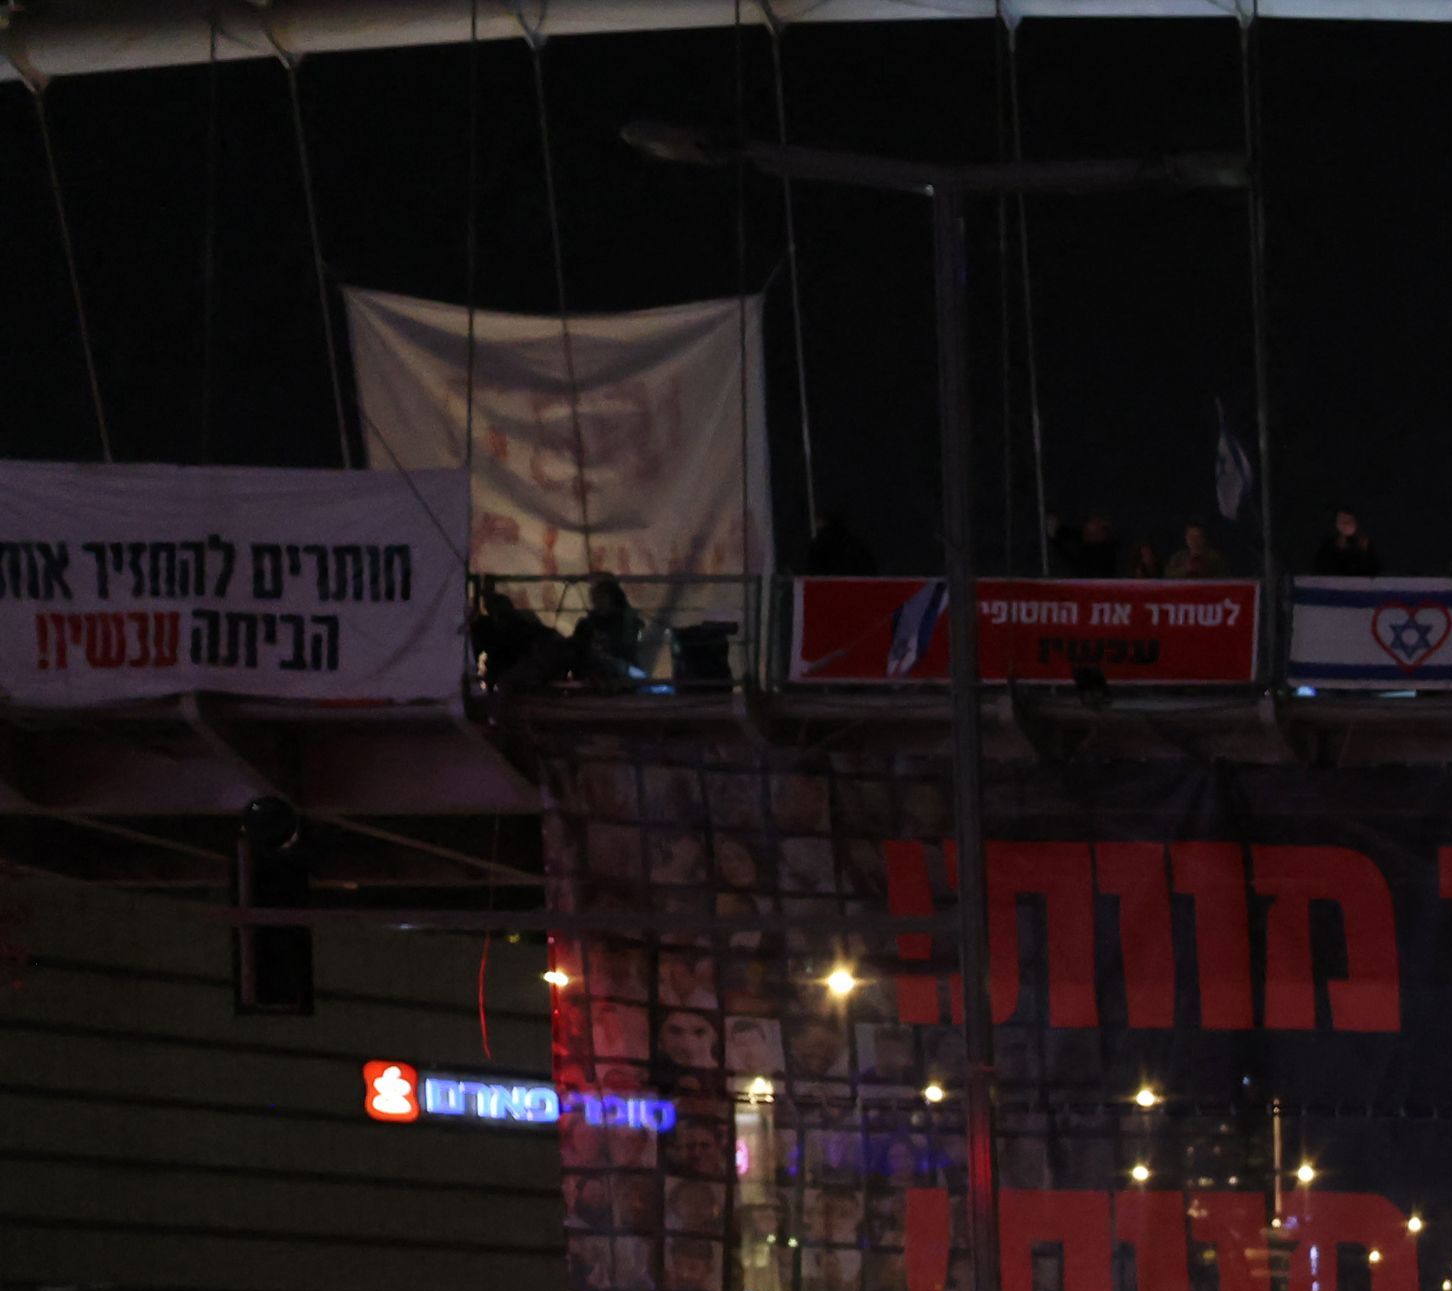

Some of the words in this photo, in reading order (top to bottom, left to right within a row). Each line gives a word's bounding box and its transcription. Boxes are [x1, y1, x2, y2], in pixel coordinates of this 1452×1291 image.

[0, 541, 72, 600] אות
[82, 533, 236, 599] להחזיר
[251, 544, 411, 602] חותרים
[36, 611, 180, 671] עכשיו!
[190, 608, 340, 671] הביתה
[981, 600, 1078, 626] החטופי
[1090, 601, 1132, 627] את
[1144, 598, 1241, 628] לשחרר
